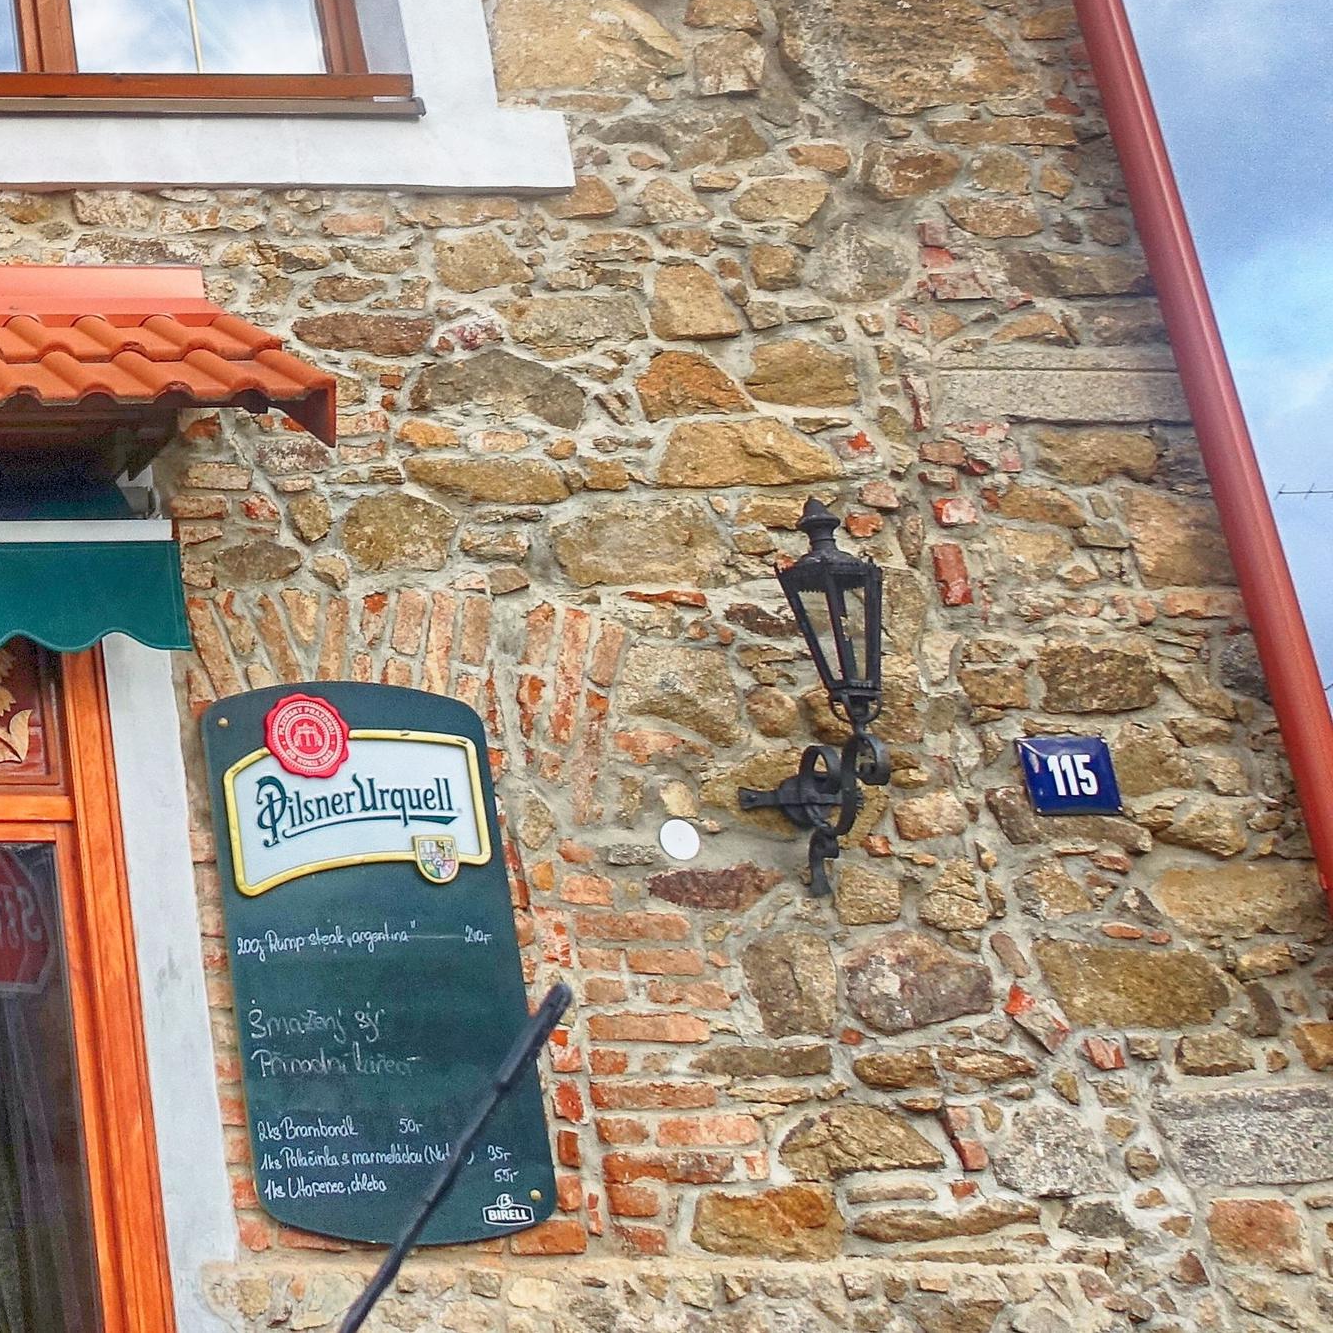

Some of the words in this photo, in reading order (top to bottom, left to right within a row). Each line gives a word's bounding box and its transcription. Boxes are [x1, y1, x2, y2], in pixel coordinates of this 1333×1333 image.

[1047, 754, 1098, 796] 115
[256, 775, 356, 848] Pilsner
[352, 773, 454, 827] Urquell
[237, 936, 266, 962] 200g
[264, 929, 305, 953] Rump
[308, 925, 345, 946] steak
[260, 1153, 283, 1170] 1ks
[264, 1179, 286, 1200] 1ks
[488, 1209, 530, 1221] BIRELL
